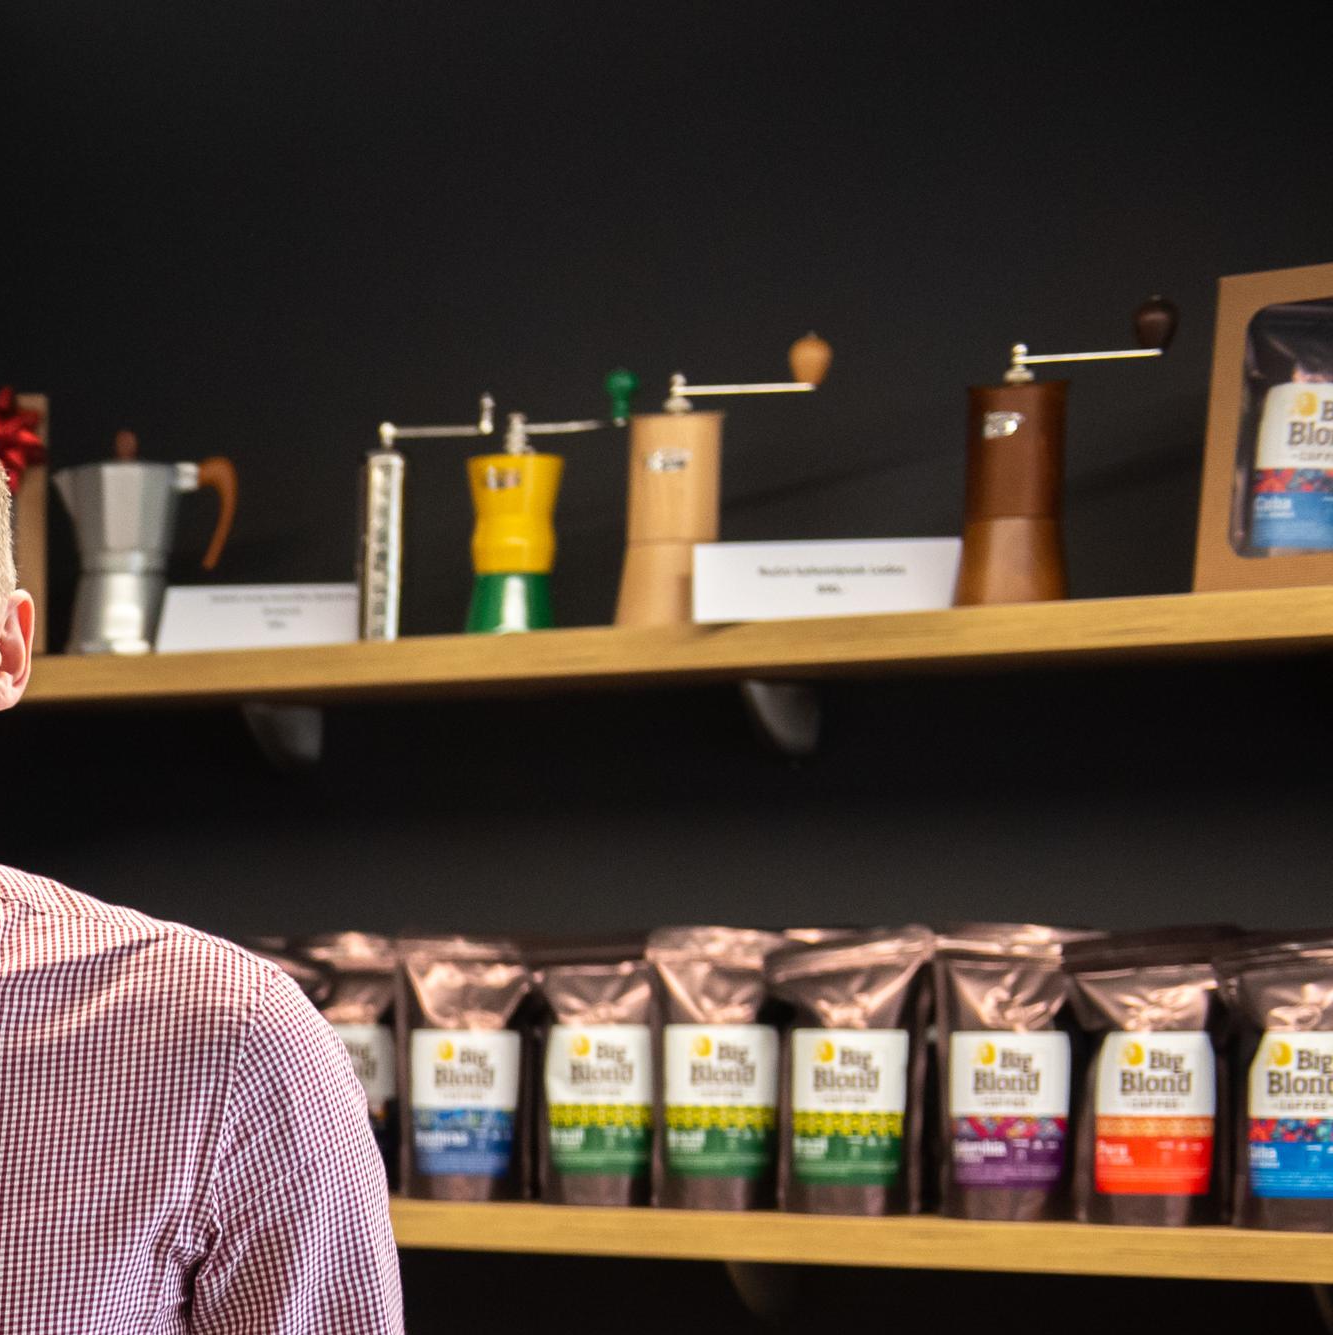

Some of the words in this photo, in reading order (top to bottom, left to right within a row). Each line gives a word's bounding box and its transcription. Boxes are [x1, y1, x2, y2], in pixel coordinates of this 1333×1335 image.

[1288, 420, 1333, 447] Blo
[1000, 1049, 1033, 1073] Big
[1149, 1050, 1184, 1073] Big
[812, 1066, 880, 1092] Blond
[973, 1069, 1041, 1095] Blond
[1119, 1069, 1193, 1095] Blond
